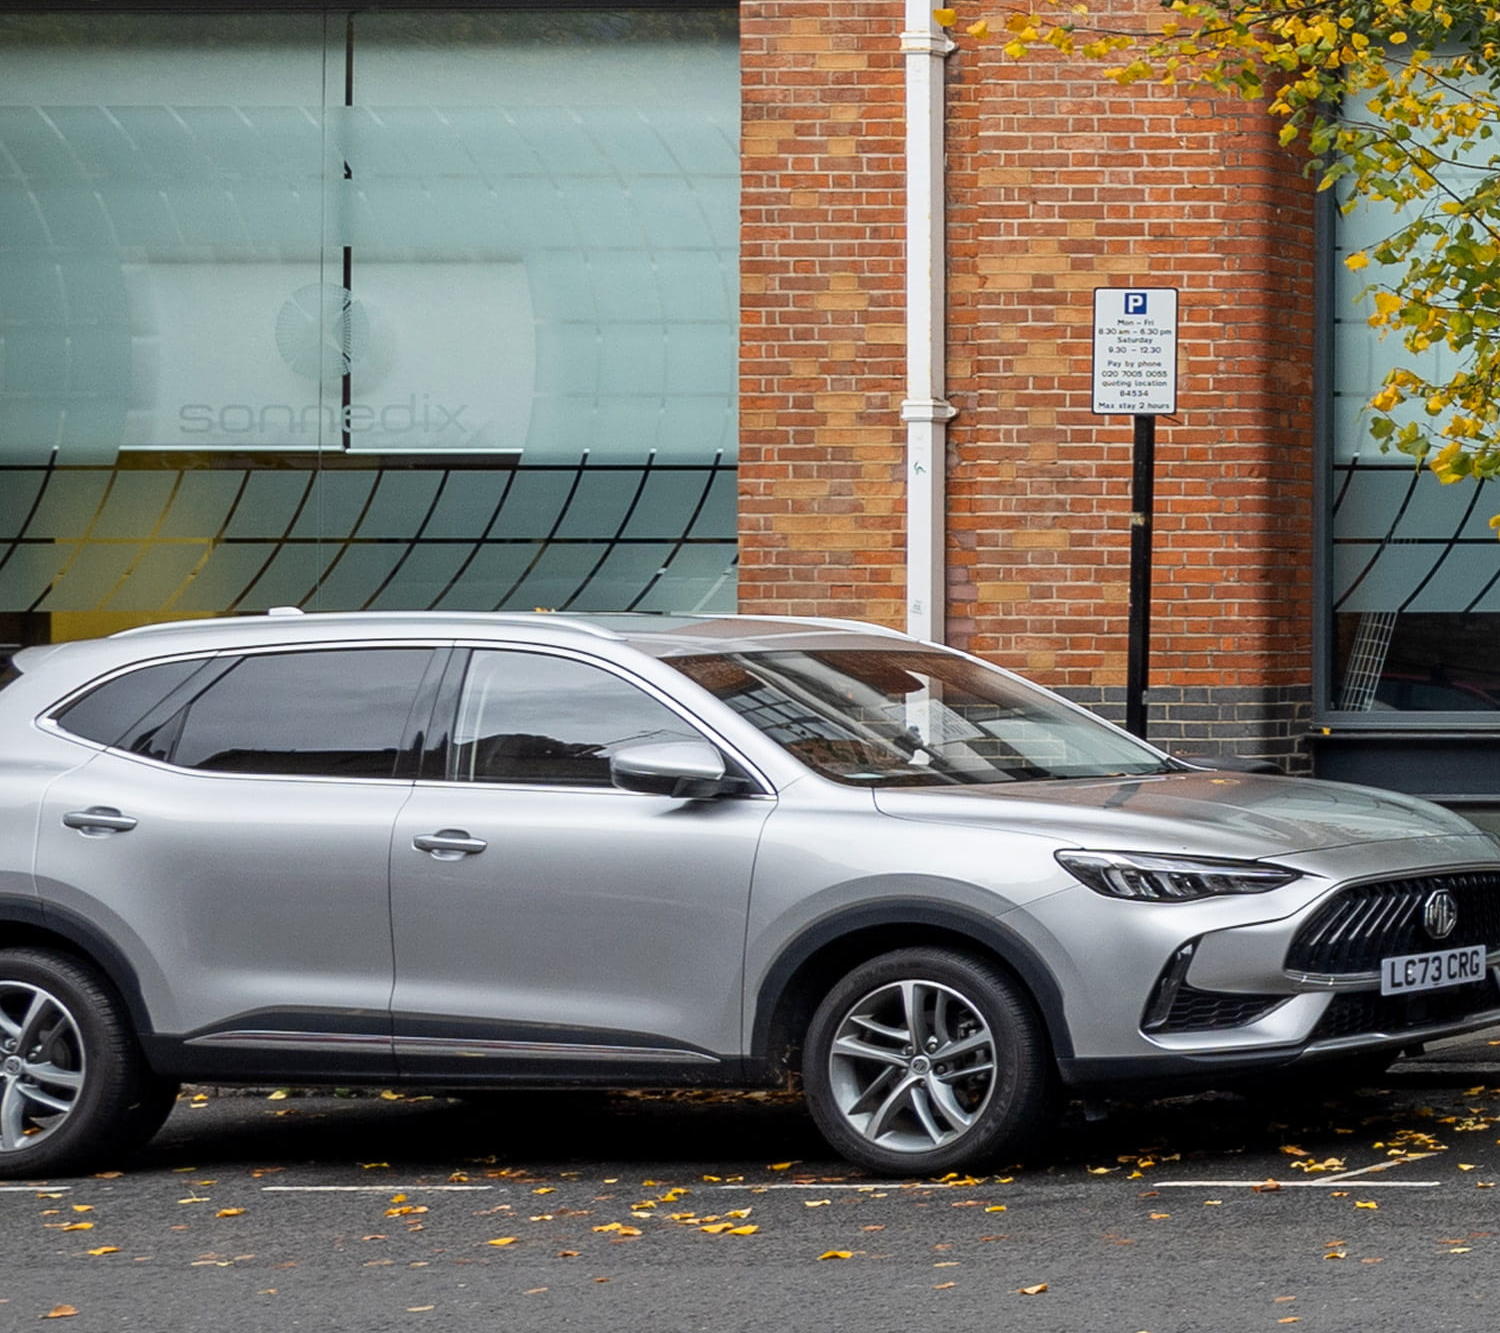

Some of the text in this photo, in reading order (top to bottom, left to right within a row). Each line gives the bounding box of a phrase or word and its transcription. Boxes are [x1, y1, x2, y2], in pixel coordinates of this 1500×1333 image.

[1128, 294, 1143, 313] P
[1107, 359, 1162, 368] Pay by phone
[179, 393, 470, 433] sonnedix
[1118, 402, 1136, 410] stay
[1390, 950, 1480, 988] LC73 CRG
